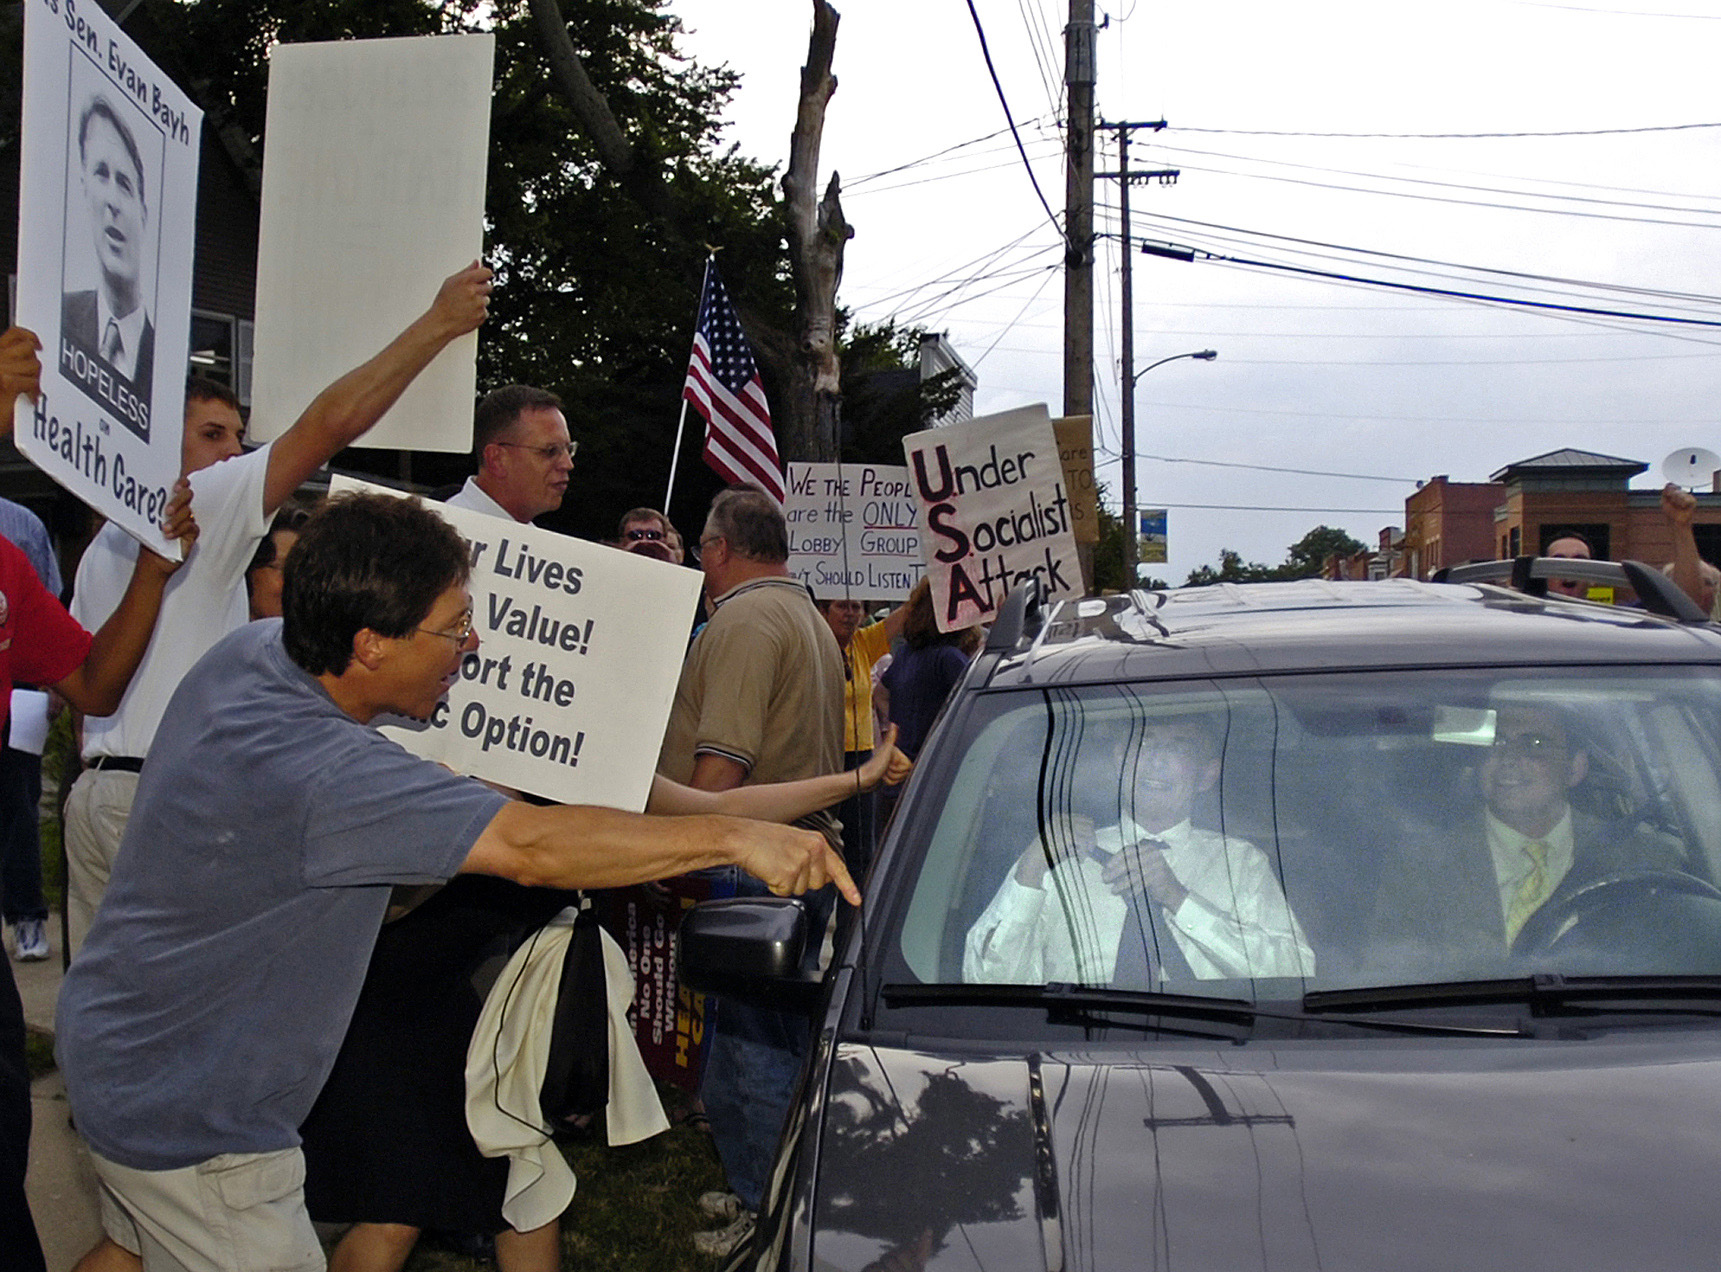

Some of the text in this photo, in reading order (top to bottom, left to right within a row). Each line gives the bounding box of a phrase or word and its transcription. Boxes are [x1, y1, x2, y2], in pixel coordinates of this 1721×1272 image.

[64, 0, 102, 58] Sen.
[109, 39, 147, 102] Evan
[152, 83, 189, 145] Bayh
[61, 338, 148, 430] HOPELESS
[33, 393, 167, 531] Health Care?
[824, 480, 850, 497] THE
[861, 468, 913, 497] PEOPL
[787, 502, 918, 527] are the ONLY
[790, 530, 918, 554] LOBBY GROUP
[464, 538, 584, 595] r Lives
[816, 561, 864, 586] SHOULD
[868, 563, 911, 589] LISTEN
[909, 564, 926, 583] T
[488, 592, 595, 655] Value!
[461, 654, 575, 706] ort the
[461, 702, 585, 767] Option!
[640, 925, 651, 1019] No One
[652, 957, 664, 1045] Should
[665, 931, 677, 1032] Without
[692, 992, 705, 1046] CA
